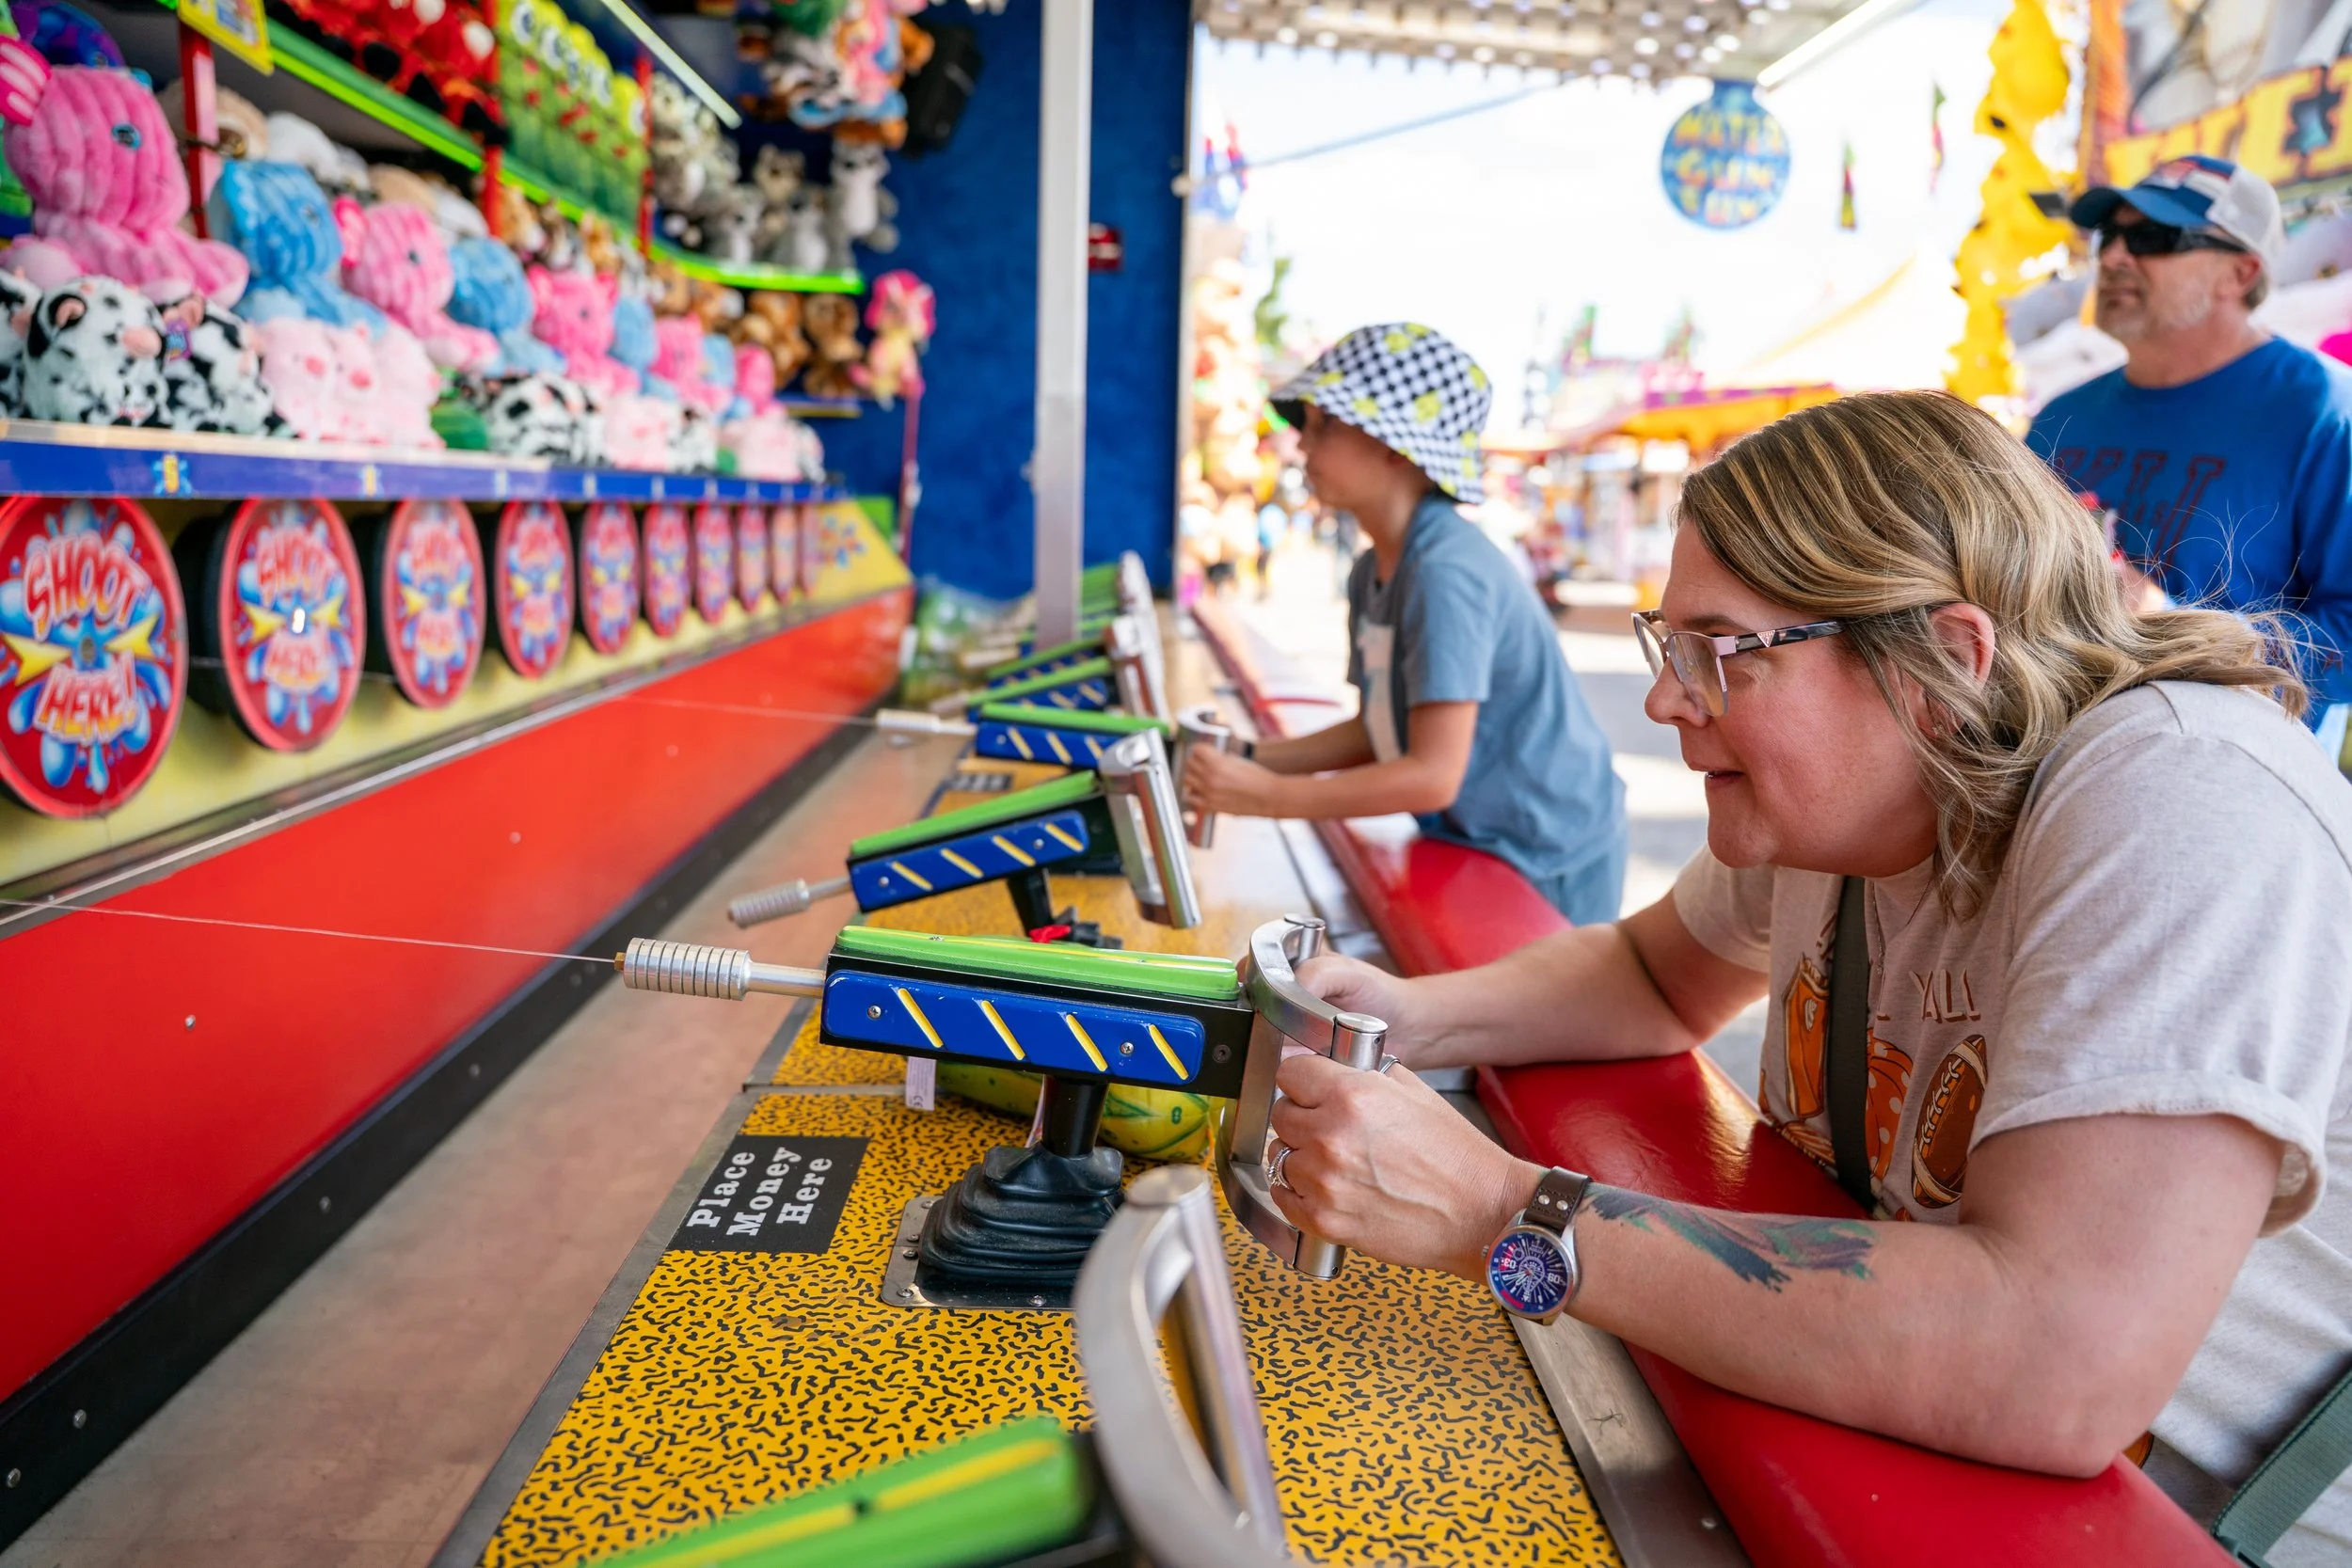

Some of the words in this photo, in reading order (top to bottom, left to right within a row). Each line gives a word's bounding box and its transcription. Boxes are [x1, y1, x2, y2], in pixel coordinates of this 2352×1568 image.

[24, 530, 151, 641] SHOOT
[33, 648, 139, 746] HERE!
[686, 1152, 755, 1227] Place
[725, 1147, 802, 1236] Money
[776, 1158, 833, 1225] Here
